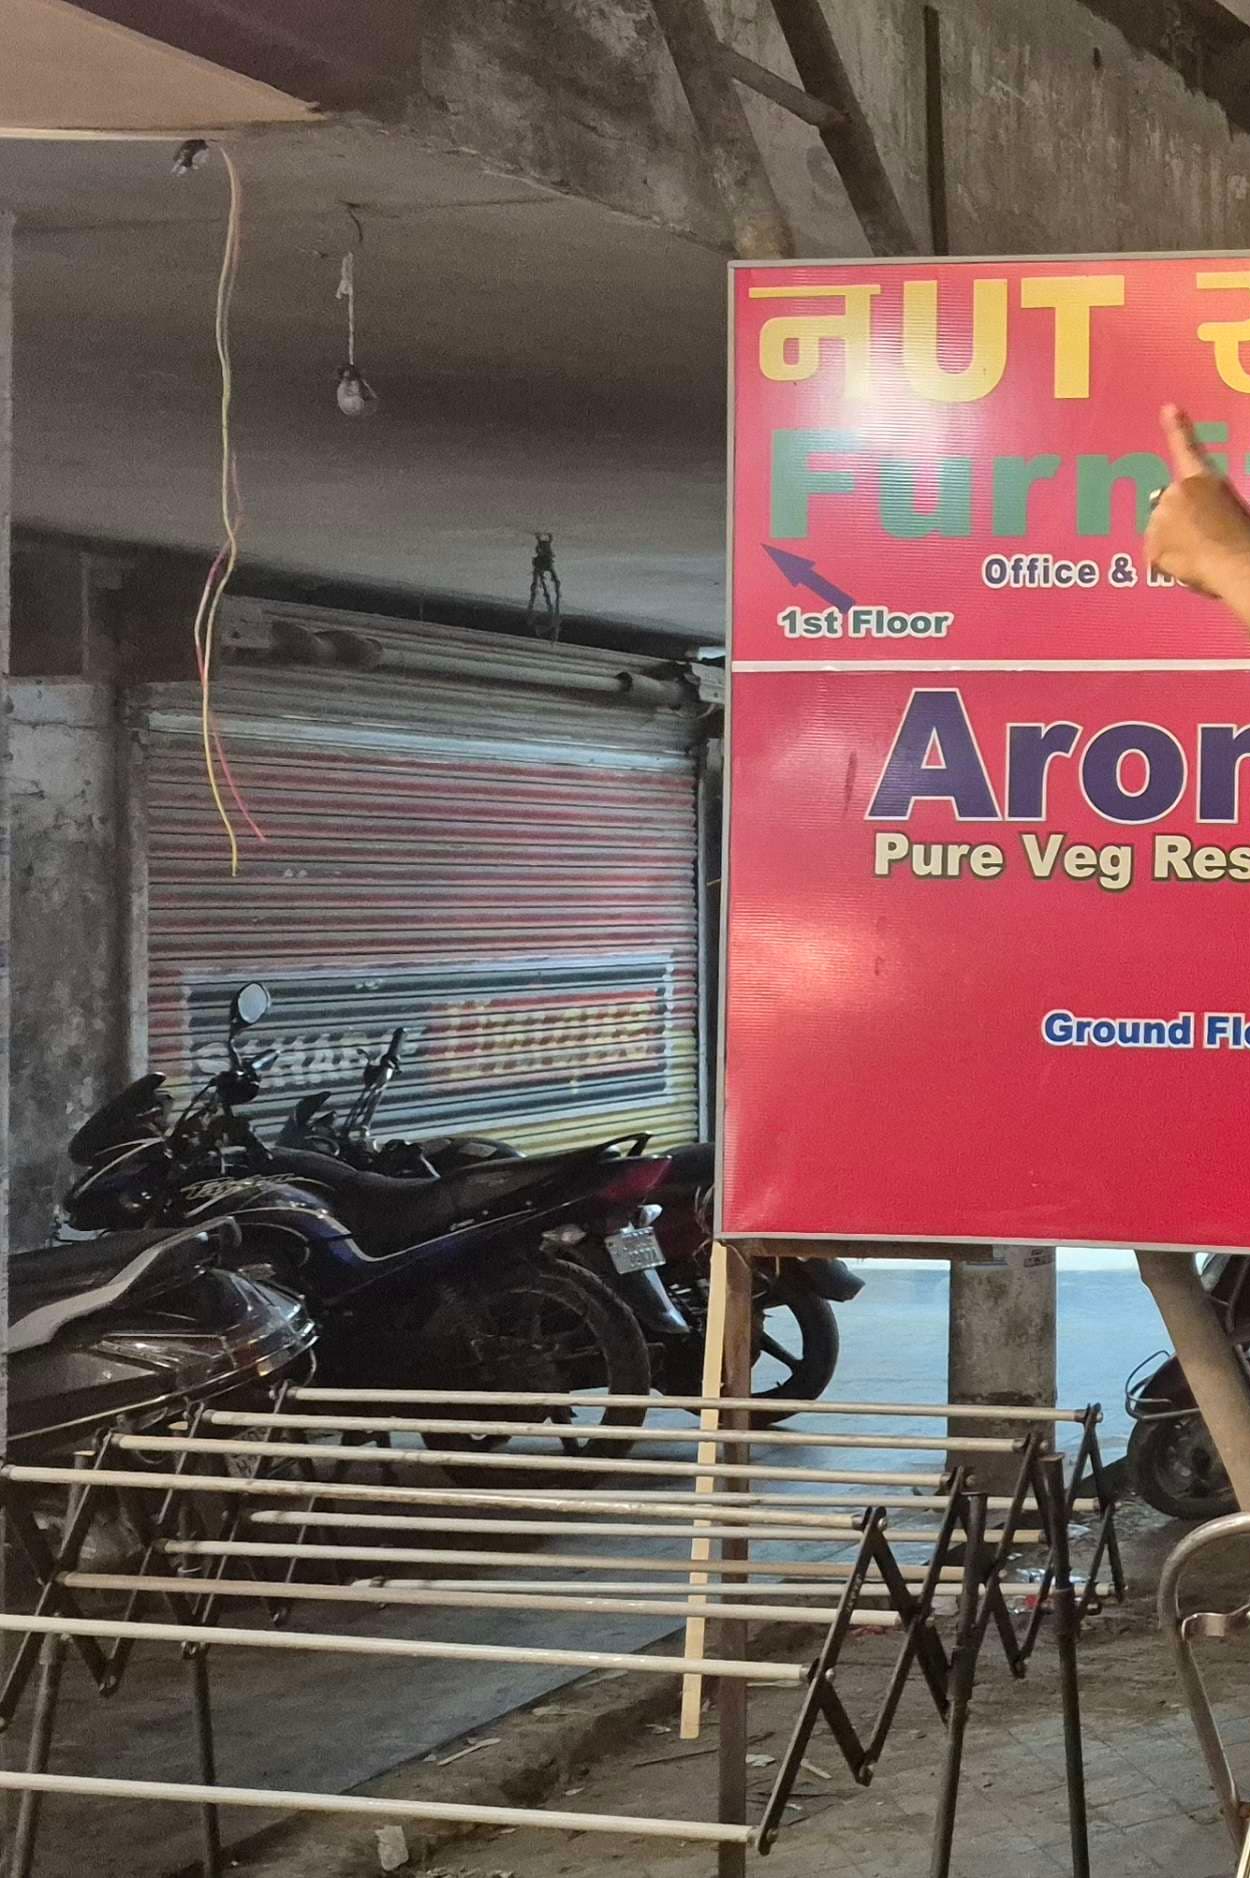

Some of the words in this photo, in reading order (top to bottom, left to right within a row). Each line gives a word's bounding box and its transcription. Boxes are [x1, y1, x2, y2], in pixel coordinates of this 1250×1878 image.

[982, 555, 1099, 588] Office
[1109, 553, 1138, 588] &
[778, 609, 841, 637] 1st
[848, 606, 954, 637] Floor
[875, 833, 1003, 878] Pure
[1022, 834, 1133, 891] Veg
[1042, 1010, 1194, 1050] Ground
